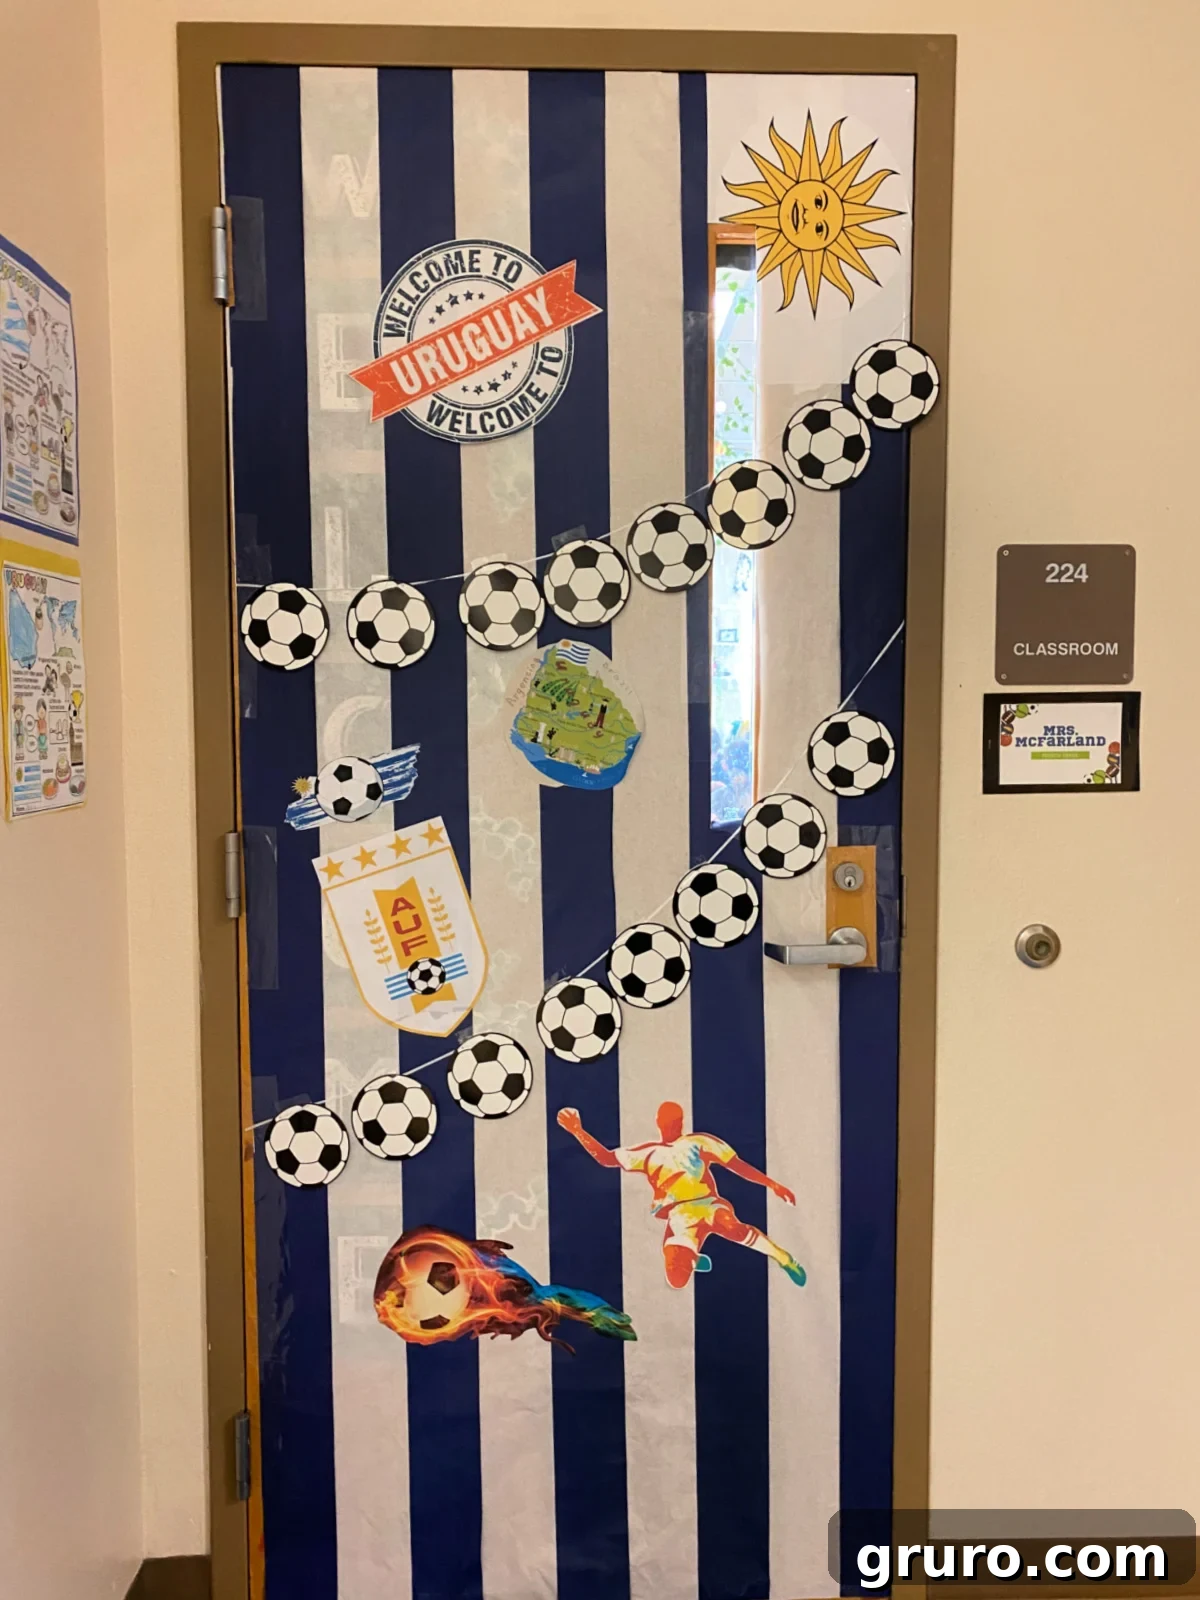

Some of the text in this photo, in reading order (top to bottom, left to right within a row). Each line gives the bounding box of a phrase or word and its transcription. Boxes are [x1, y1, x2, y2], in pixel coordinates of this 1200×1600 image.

[383, 250, 523, 338] WELCOME TO
[390, 286, 554, 395] URUGUAY
[426, 346, 563, 434] WELCOME TO
[1045, 563, 1088, 583] 224
[1013, 642, 1119, 656] CLASSROOM
[1043, 725, 1079, 736] MRS.
[390, 896, 428, 957] AUF
